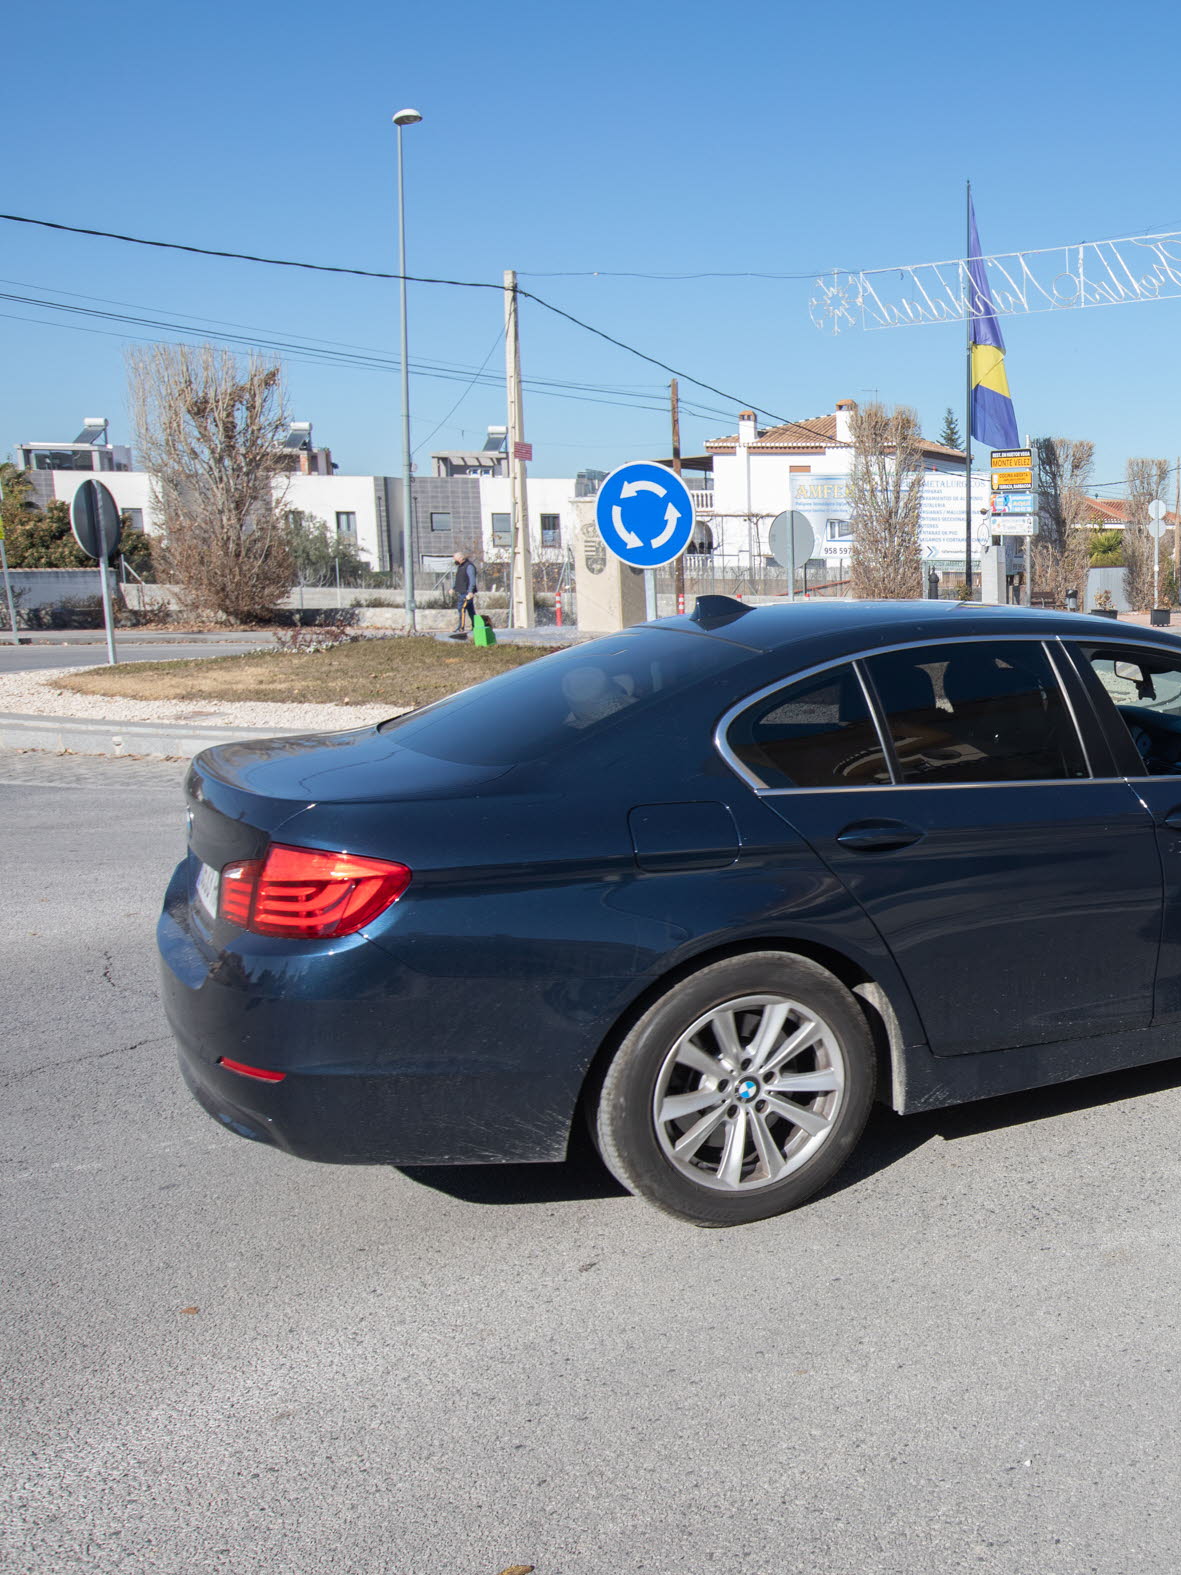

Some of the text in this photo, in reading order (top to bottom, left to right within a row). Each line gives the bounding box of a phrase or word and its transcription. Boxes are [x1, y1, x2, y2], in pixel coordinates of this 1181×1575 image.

[993, 458, 1030, 467] MONTE VELEZ
[923, 480, 986, 488] METALURGCOS
[824, 547, 837, 555] 958
